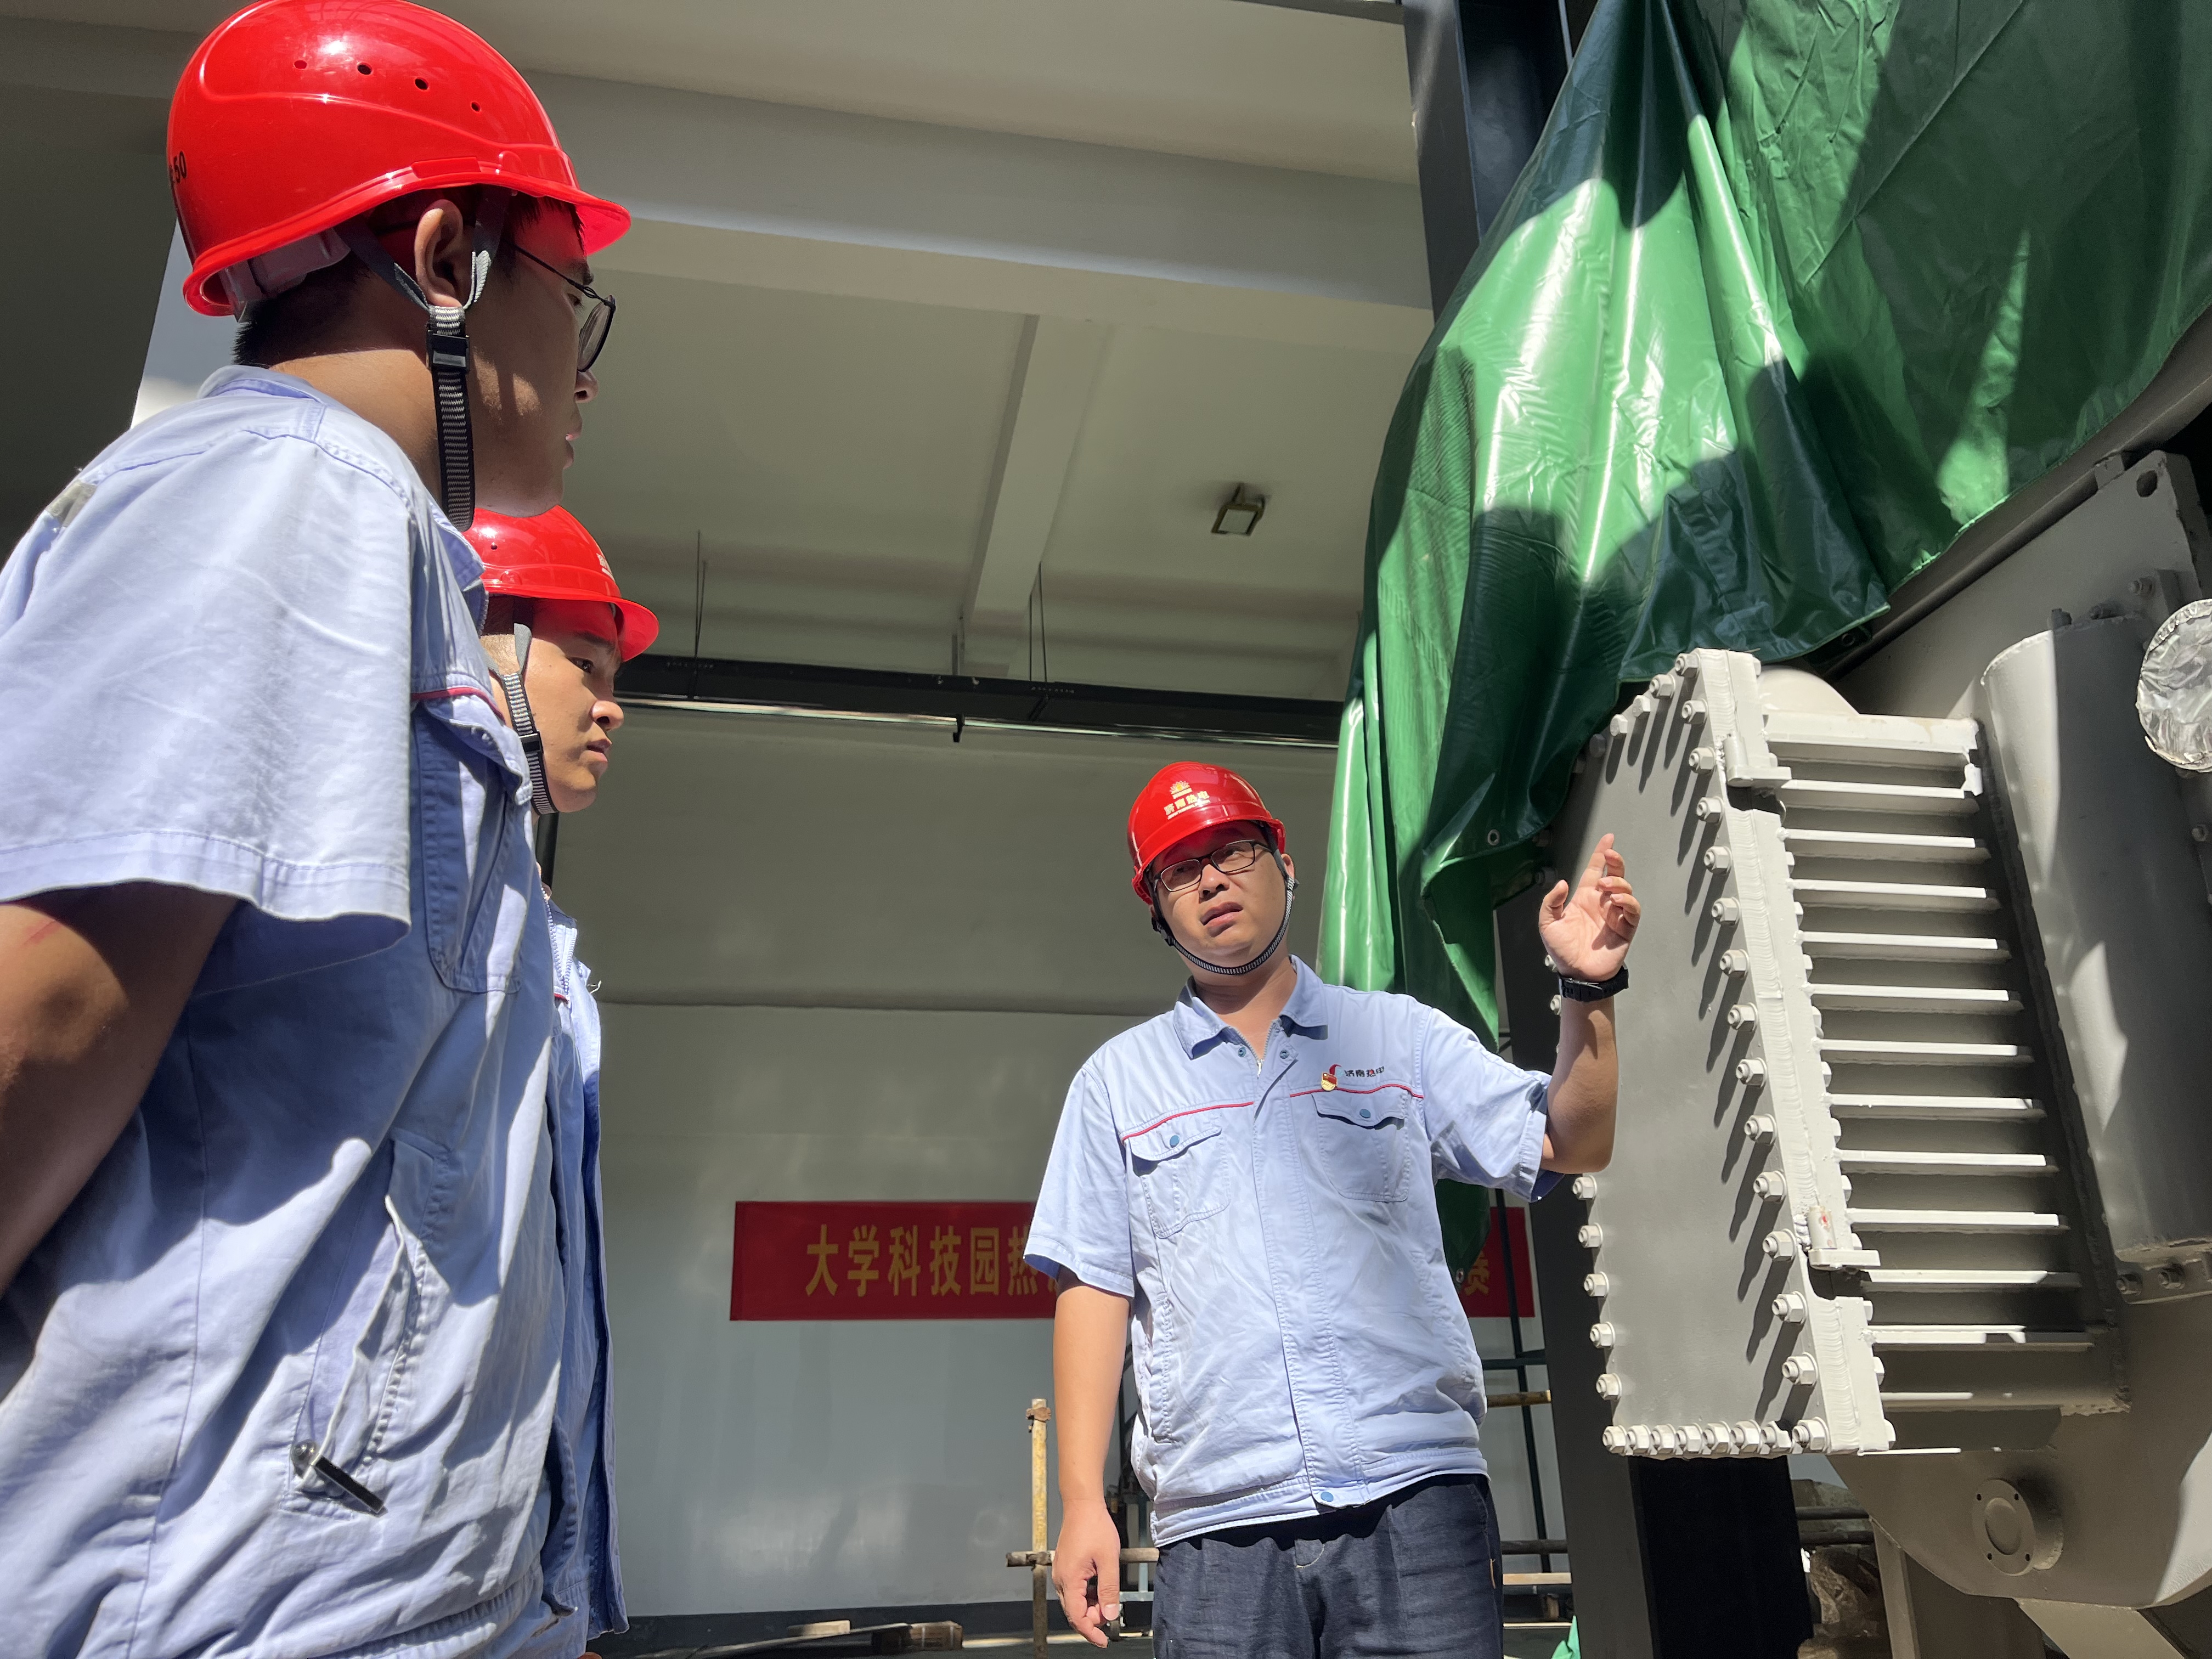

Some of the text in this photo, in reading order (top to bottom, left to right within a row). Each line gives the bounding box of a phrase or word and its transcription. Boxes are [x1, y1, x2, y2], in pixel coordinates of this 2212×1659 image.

[805, 1223, 1057, 1297] 大学科技园热
